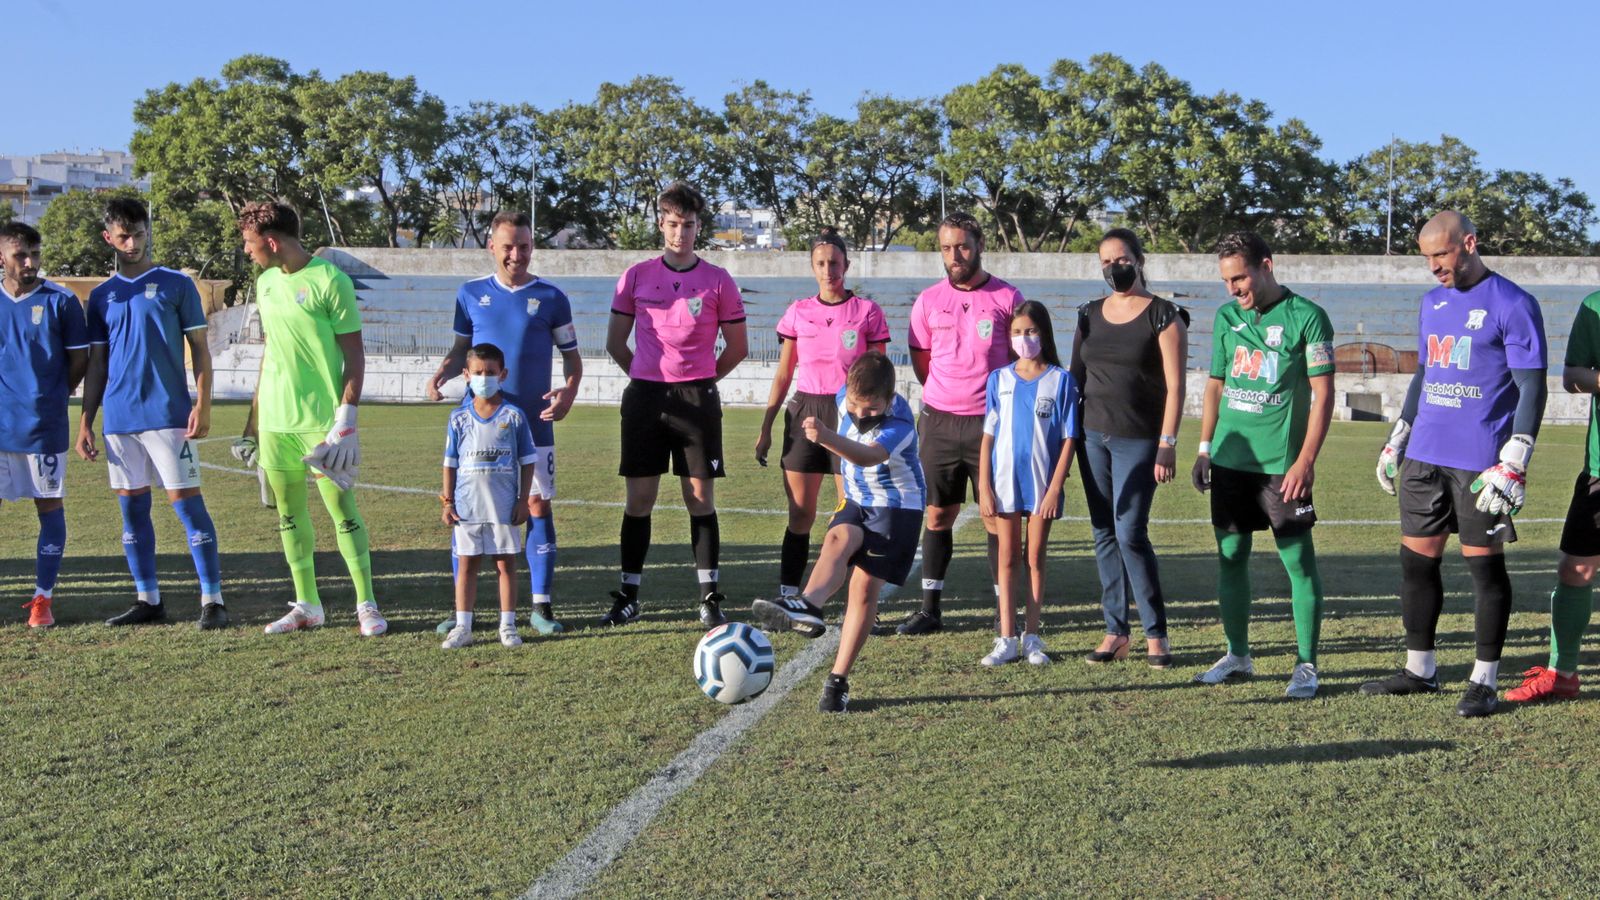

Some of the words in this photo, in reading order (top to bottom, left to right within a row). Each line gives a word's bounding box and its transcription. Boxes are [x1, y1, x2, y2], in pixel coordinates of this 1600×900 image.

[180, 440, 192, 463] 4
[547, 451, 554, 475] 8
[35, 453, 58, 477] 19
